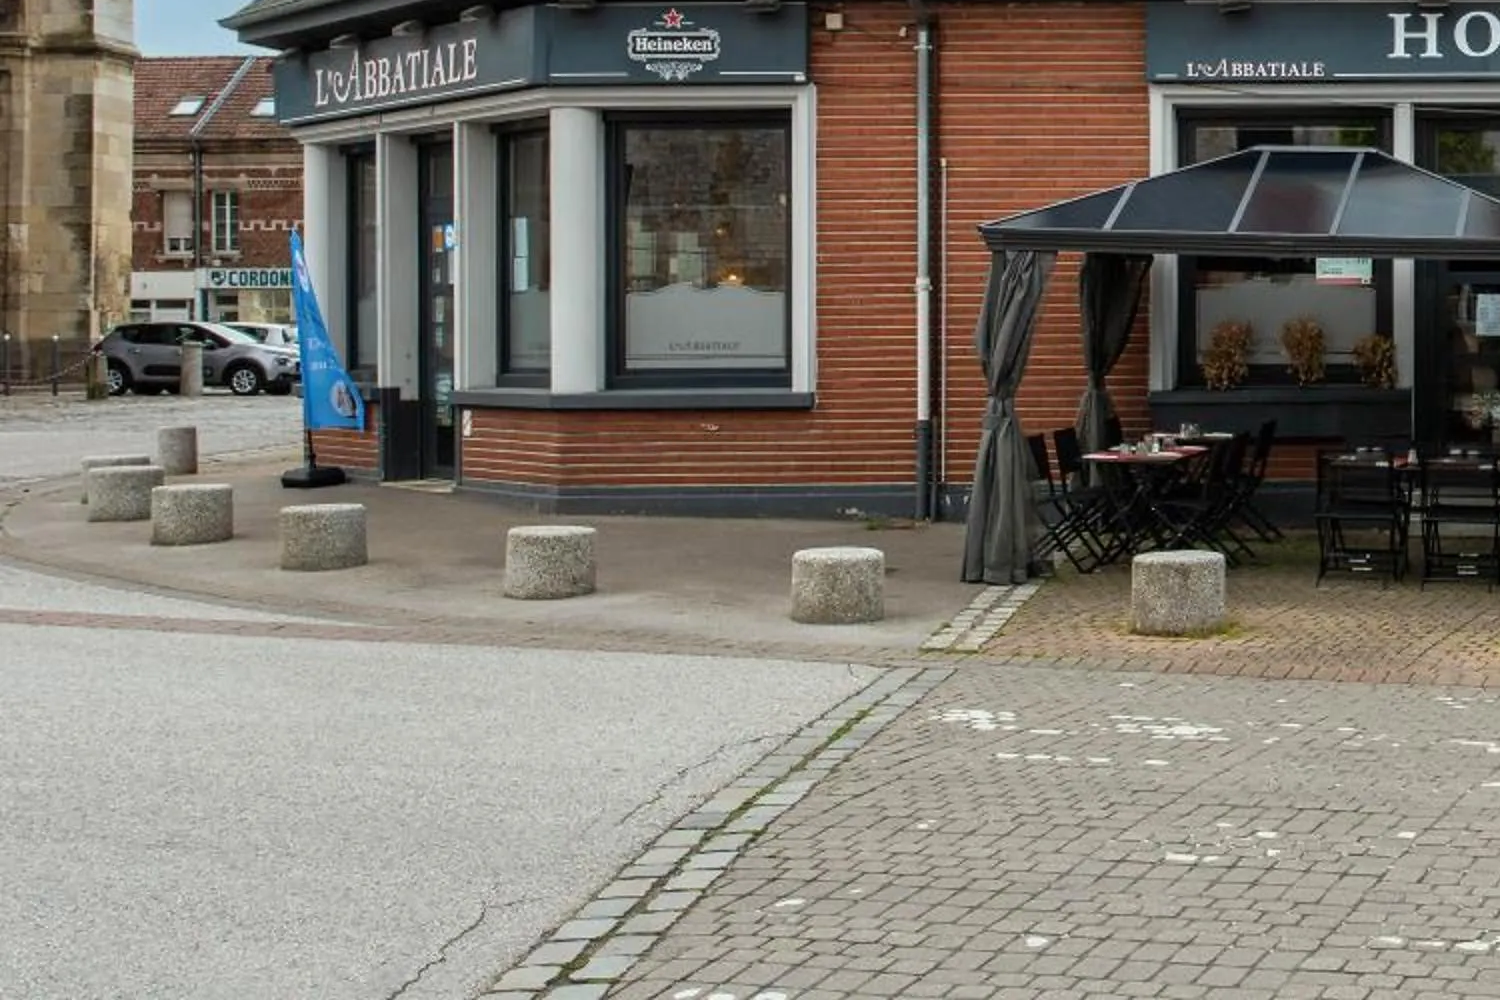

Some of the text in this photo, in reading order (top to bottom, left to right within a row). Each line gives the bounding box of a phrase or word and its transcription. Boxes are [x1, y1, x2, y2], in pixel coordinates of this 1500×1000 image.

[635, 37, 712, 52] Heineken
[314, 38, 478, 107] L'ABBATIALE
[1187, 58, 1325, 77] L'ABBATIALE
[228, 270, 294, 286] CORDON
